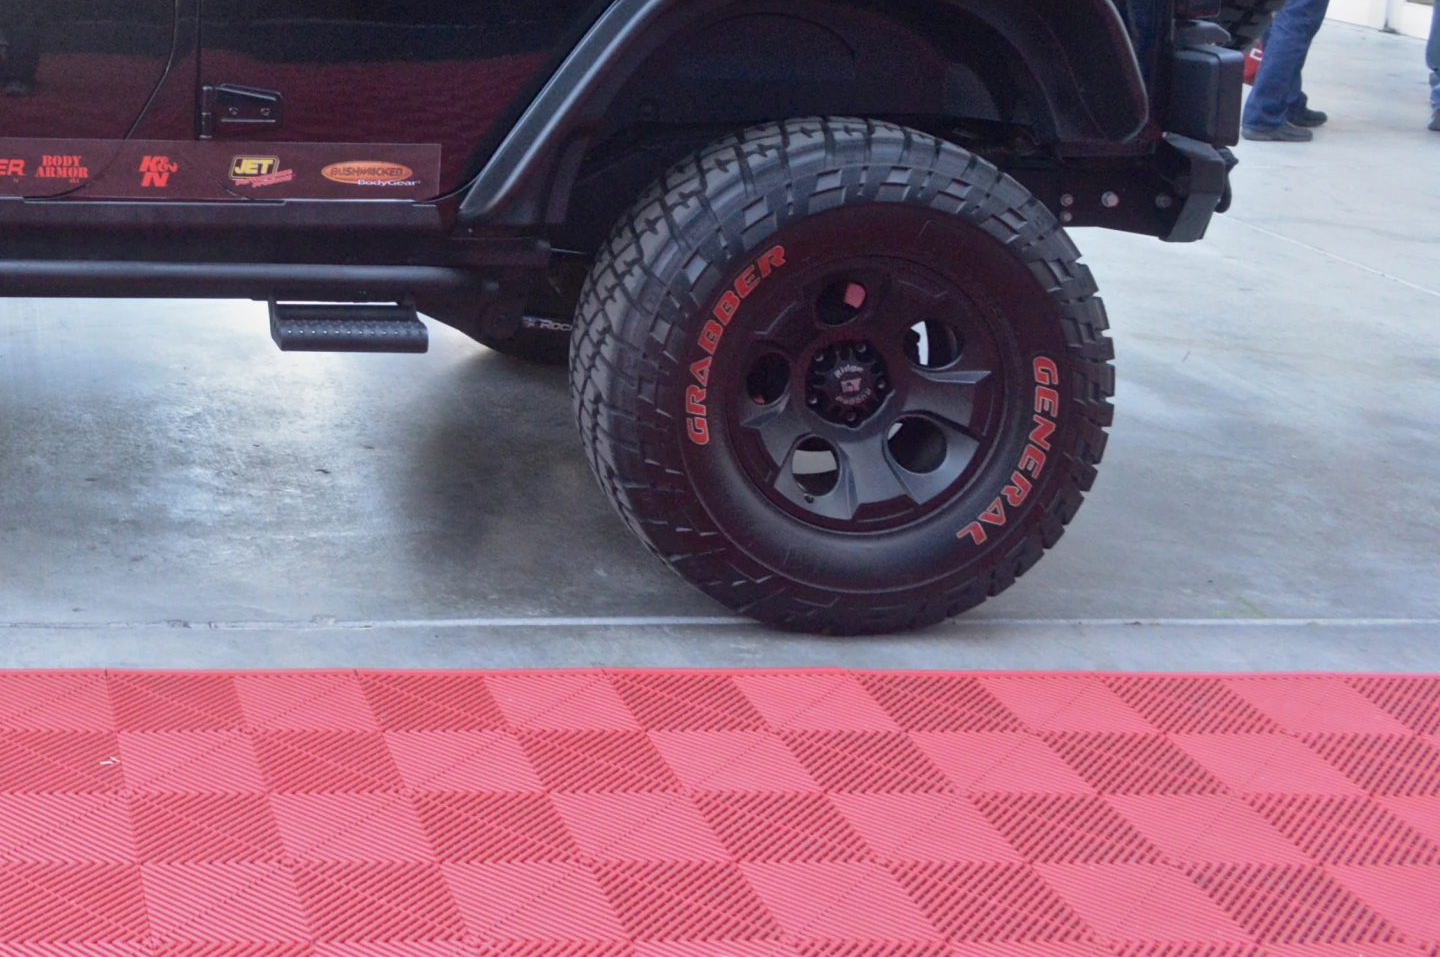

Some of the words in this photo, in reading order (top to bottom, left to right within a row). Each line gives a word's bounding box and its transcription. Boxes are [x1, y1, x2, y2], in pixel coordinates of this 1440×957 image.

[42, 155, 82, 166] BODY
[234, 159, 274, 175] JET
[34, 166, 89, 178] ARMOR
[685, 244, 787, 446] GRABBER
[956, 355, 1059, 546] GENERAL
